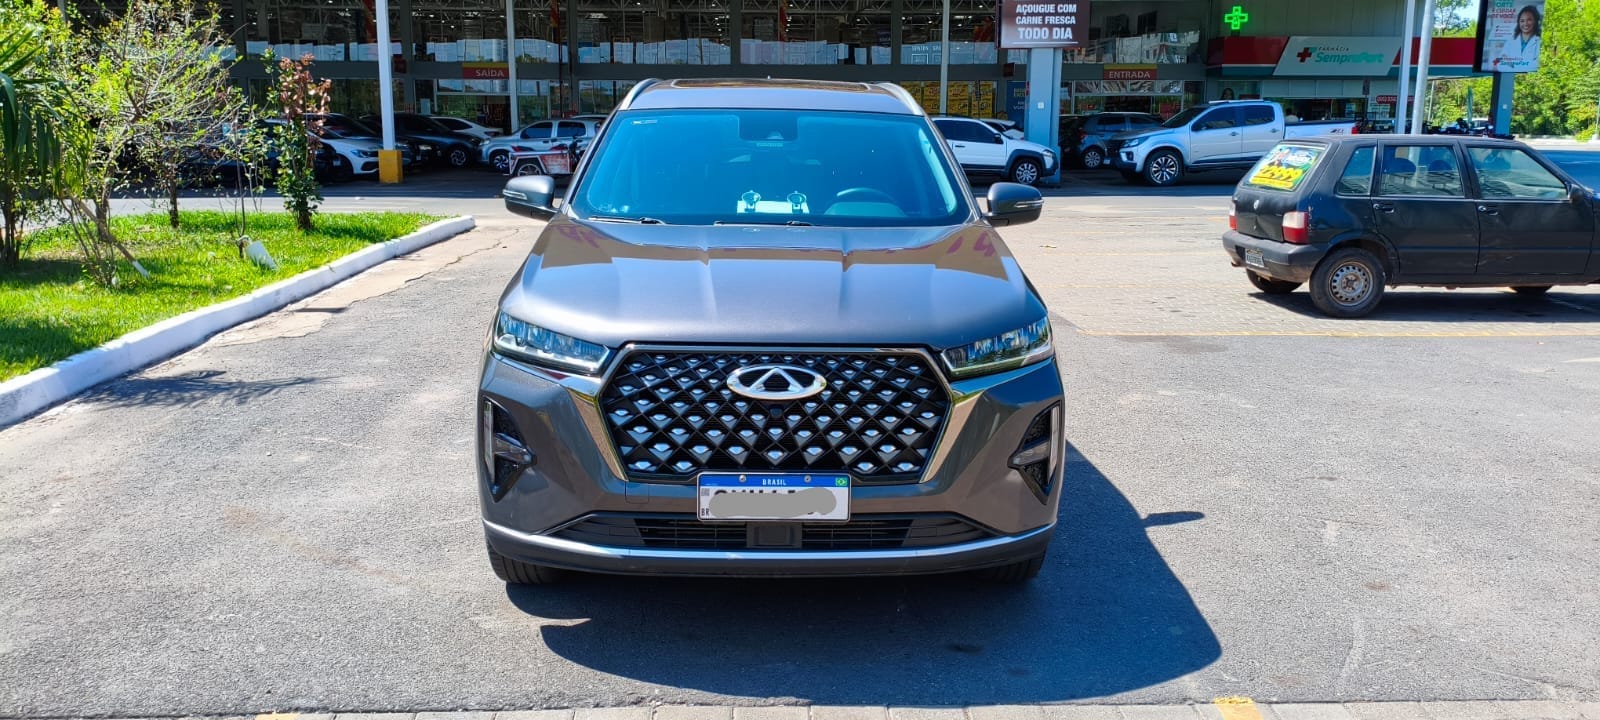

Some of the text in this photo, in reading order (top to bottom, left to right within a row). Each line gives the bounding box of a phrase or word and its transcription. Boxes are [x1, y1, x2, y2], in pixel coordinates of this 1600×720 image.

[1016, 4, 1077, 15] AÇOUGUE COM
[1016, 16, 1076, 25] CARNE FRESCA
[1017, 28, 1073, 40] TODO DIA
[475, 68, 505, 77] SAÍDA
[1109, 71, 1151, 79] ENTRADA
[762, 478, 787, 486] BRASIL
